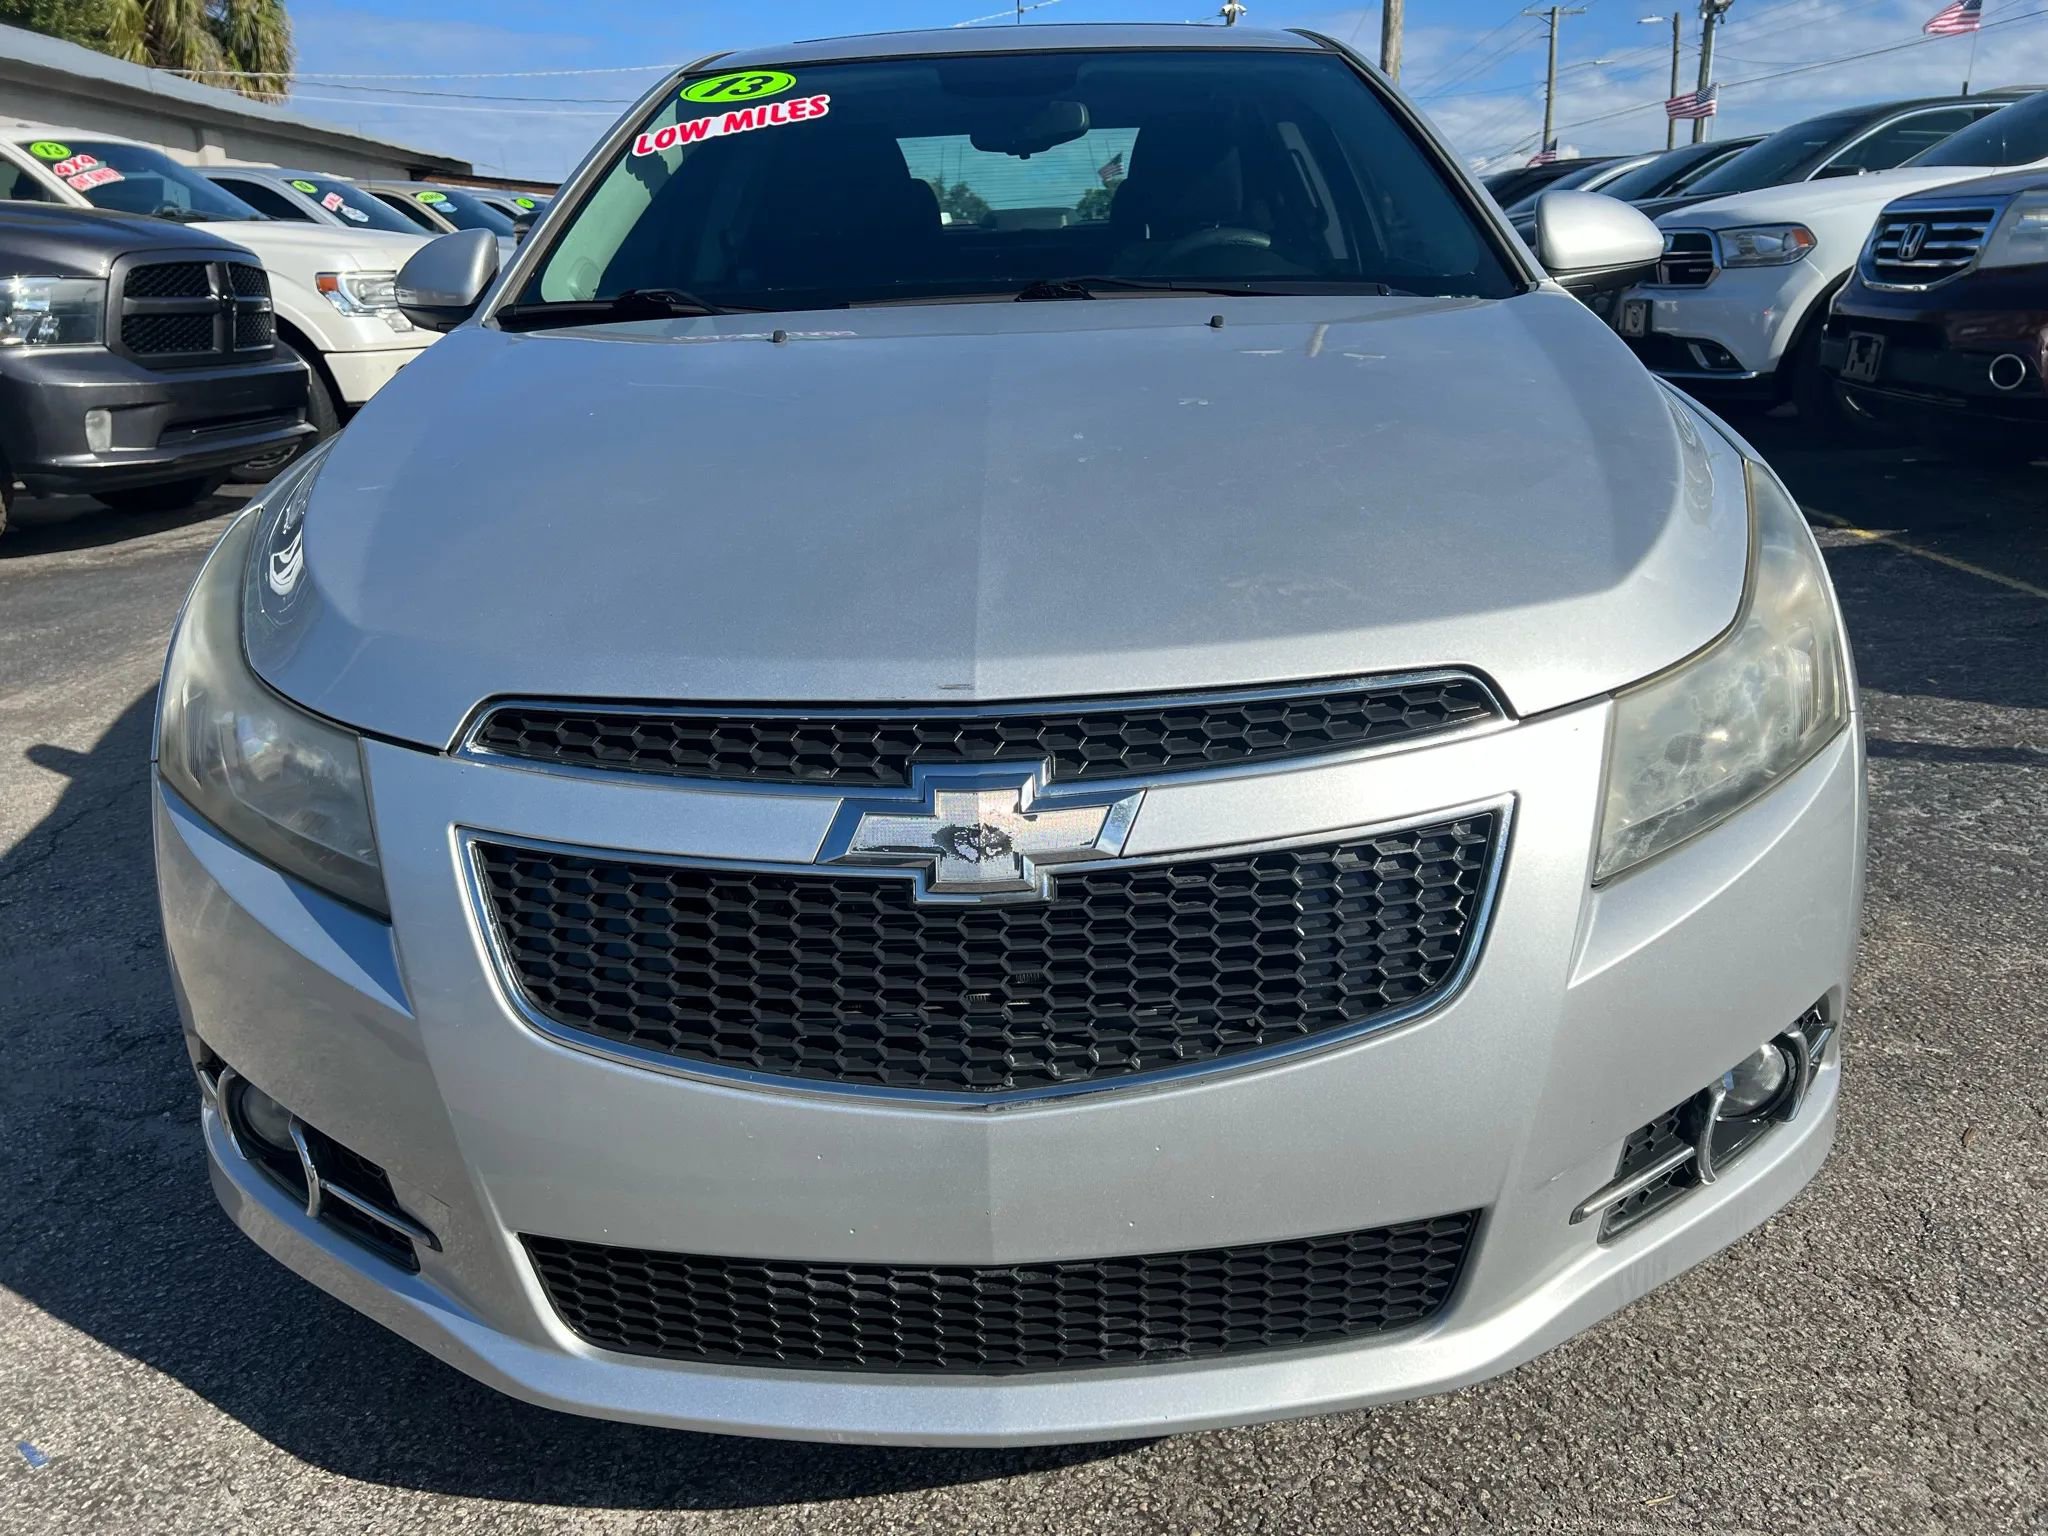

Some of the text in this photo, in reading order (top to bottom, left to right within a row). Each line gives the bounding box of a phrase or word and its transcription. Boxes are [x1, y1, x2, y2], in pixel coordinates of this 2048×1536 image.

[700, 75, 774, 97] 13
[637, 96, 828, 154] LOW MILES
